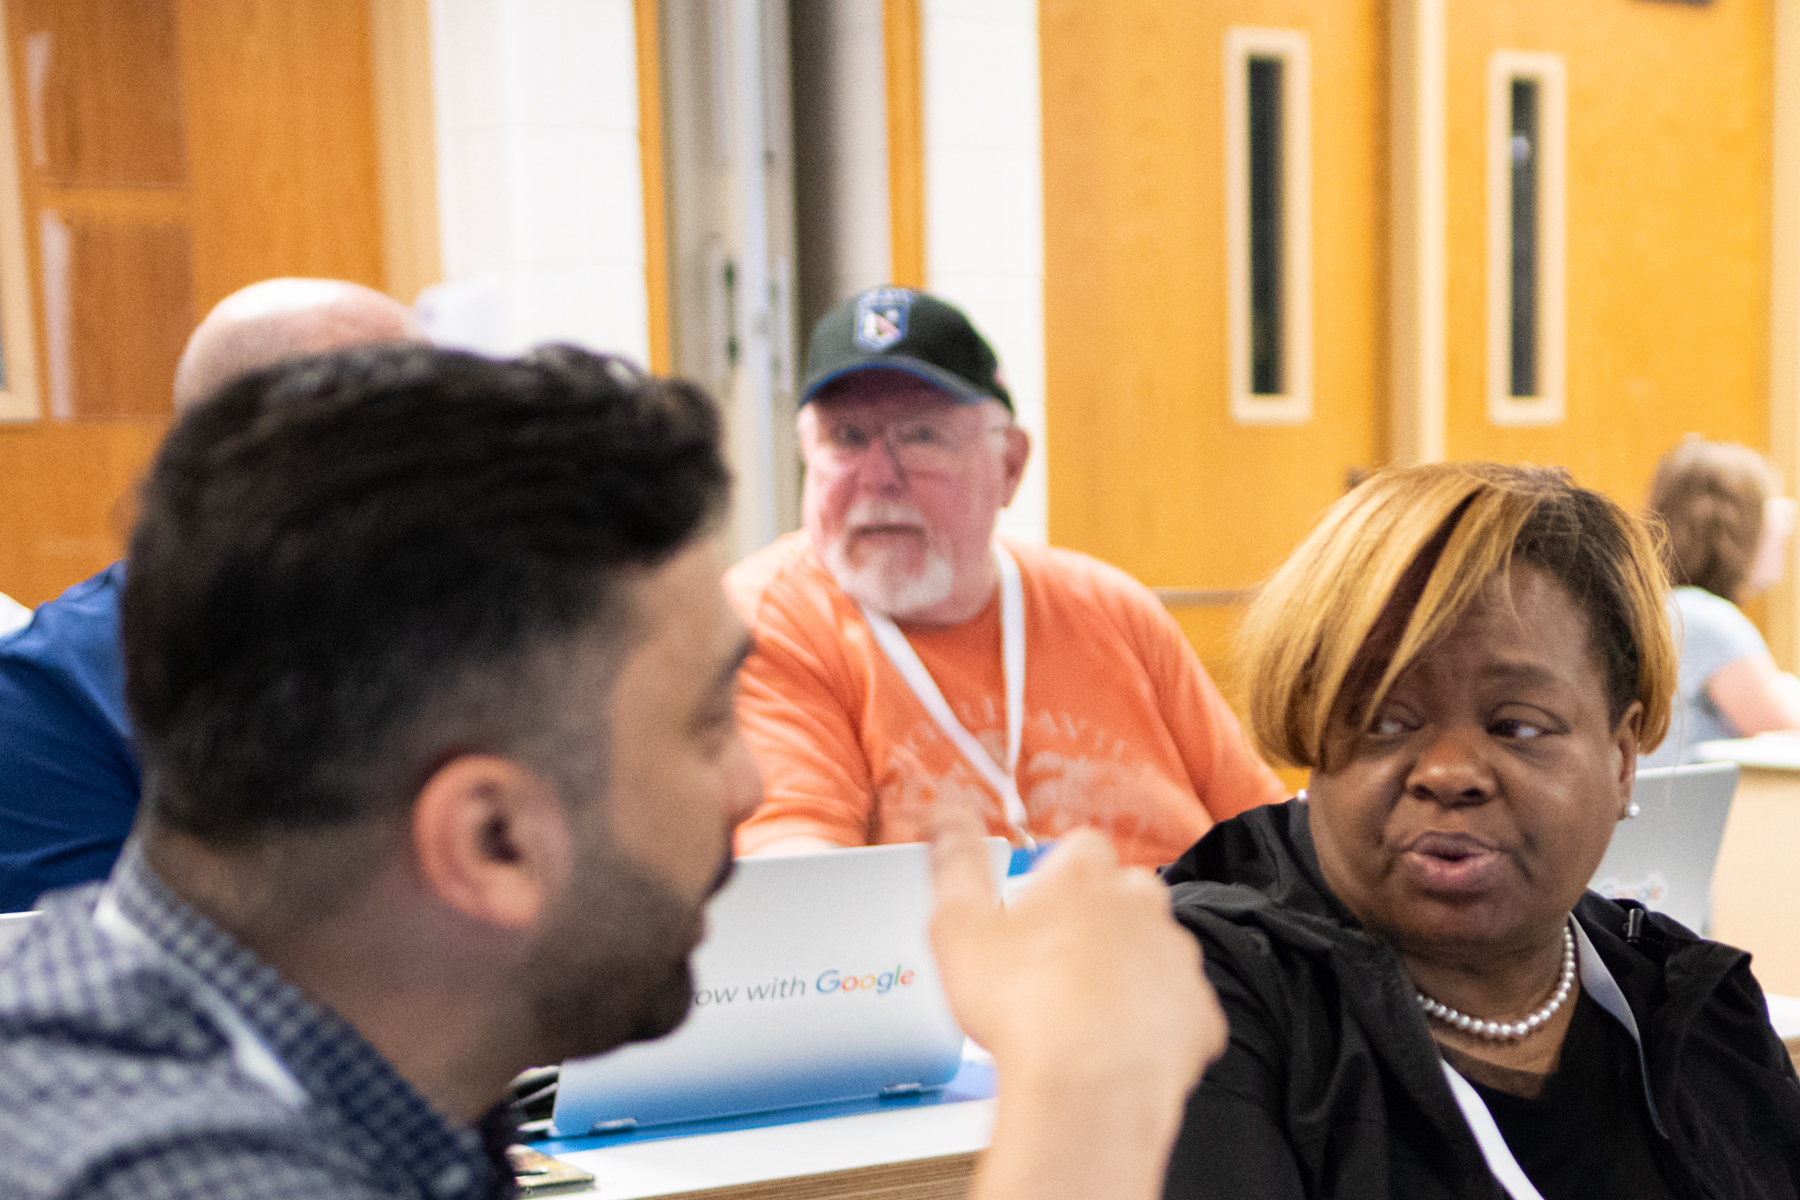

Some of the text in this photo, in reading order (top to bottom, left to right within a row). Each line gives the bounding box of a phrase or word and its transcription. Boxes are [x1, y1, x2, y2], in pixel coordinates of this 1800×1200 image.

[693, 963, 916, 1007] ow with Google
